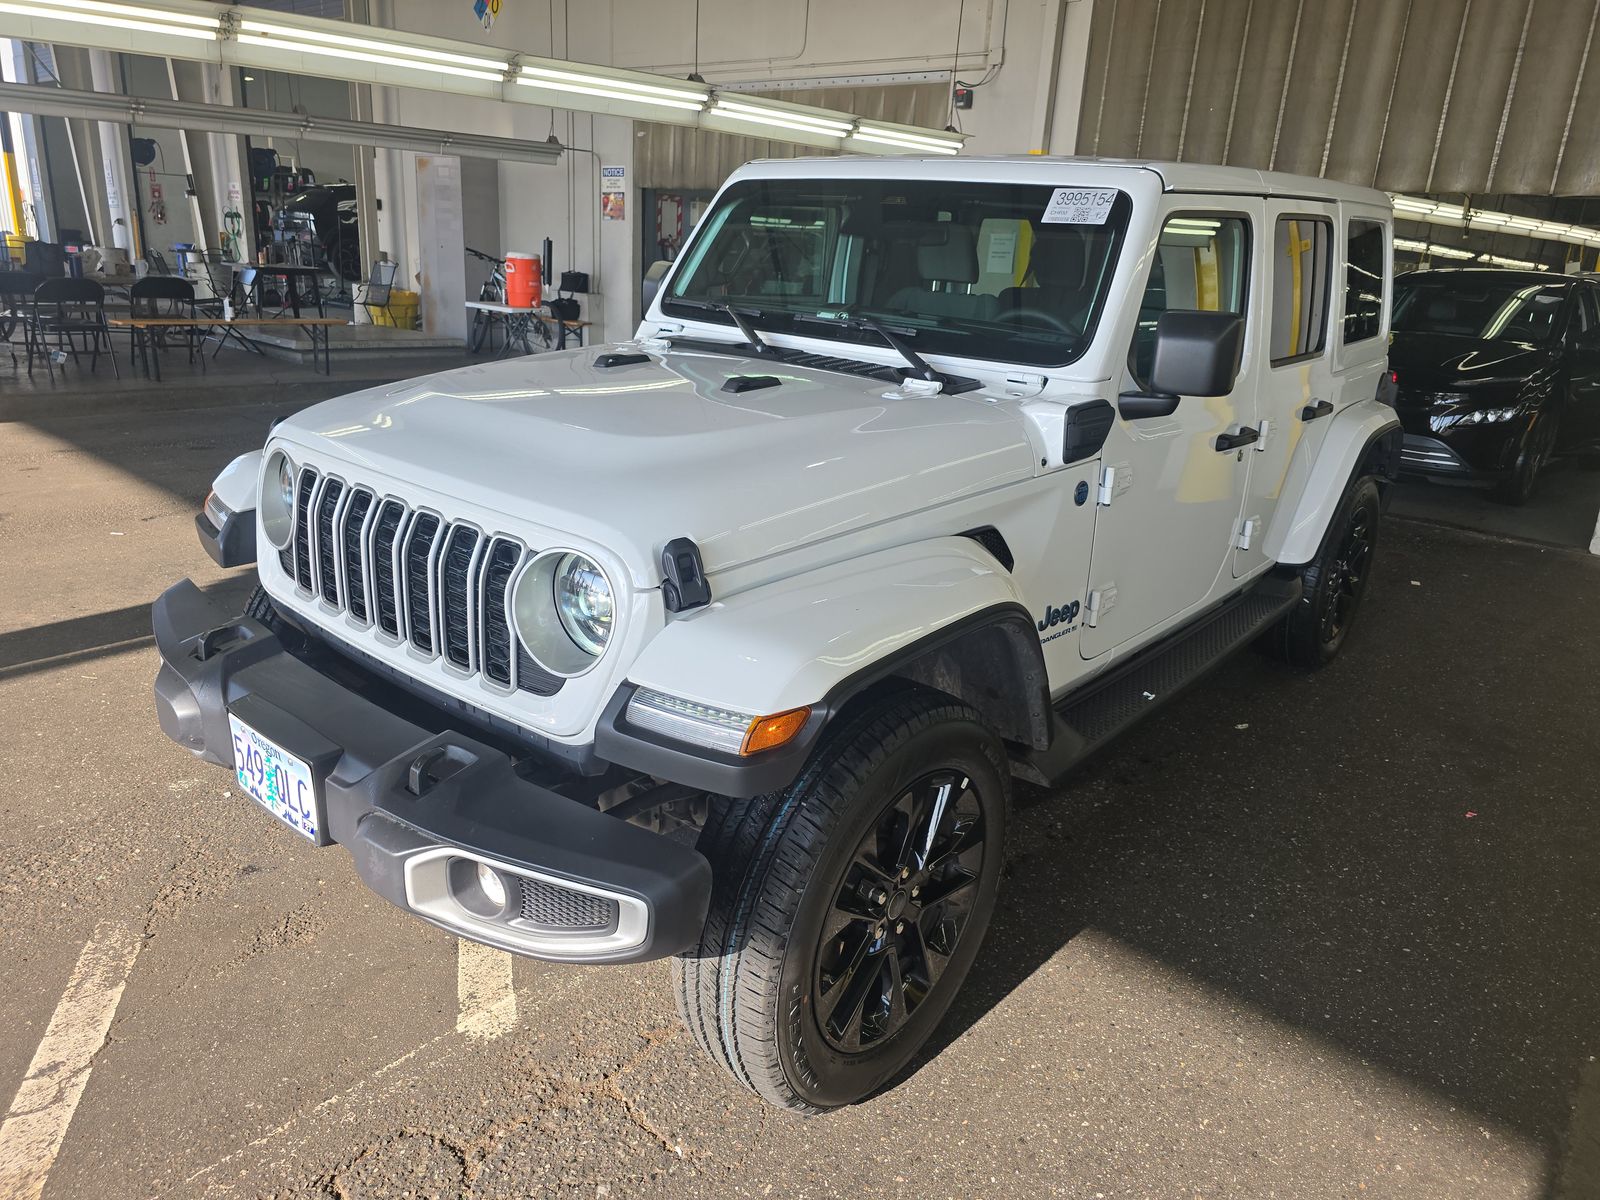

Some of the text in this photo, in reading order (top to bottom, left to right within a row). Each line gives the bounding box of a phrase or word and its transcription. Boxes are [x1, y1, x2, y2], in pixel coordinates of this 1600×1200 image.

[603, 168, 624, 177] NOTICE
[1056, 192, 1115, 206] 3995154
[1038, 600, 1080, 631] Jeep
[233, 733, 265, 786] 549
[251, 732, 282, 762] Oregon
